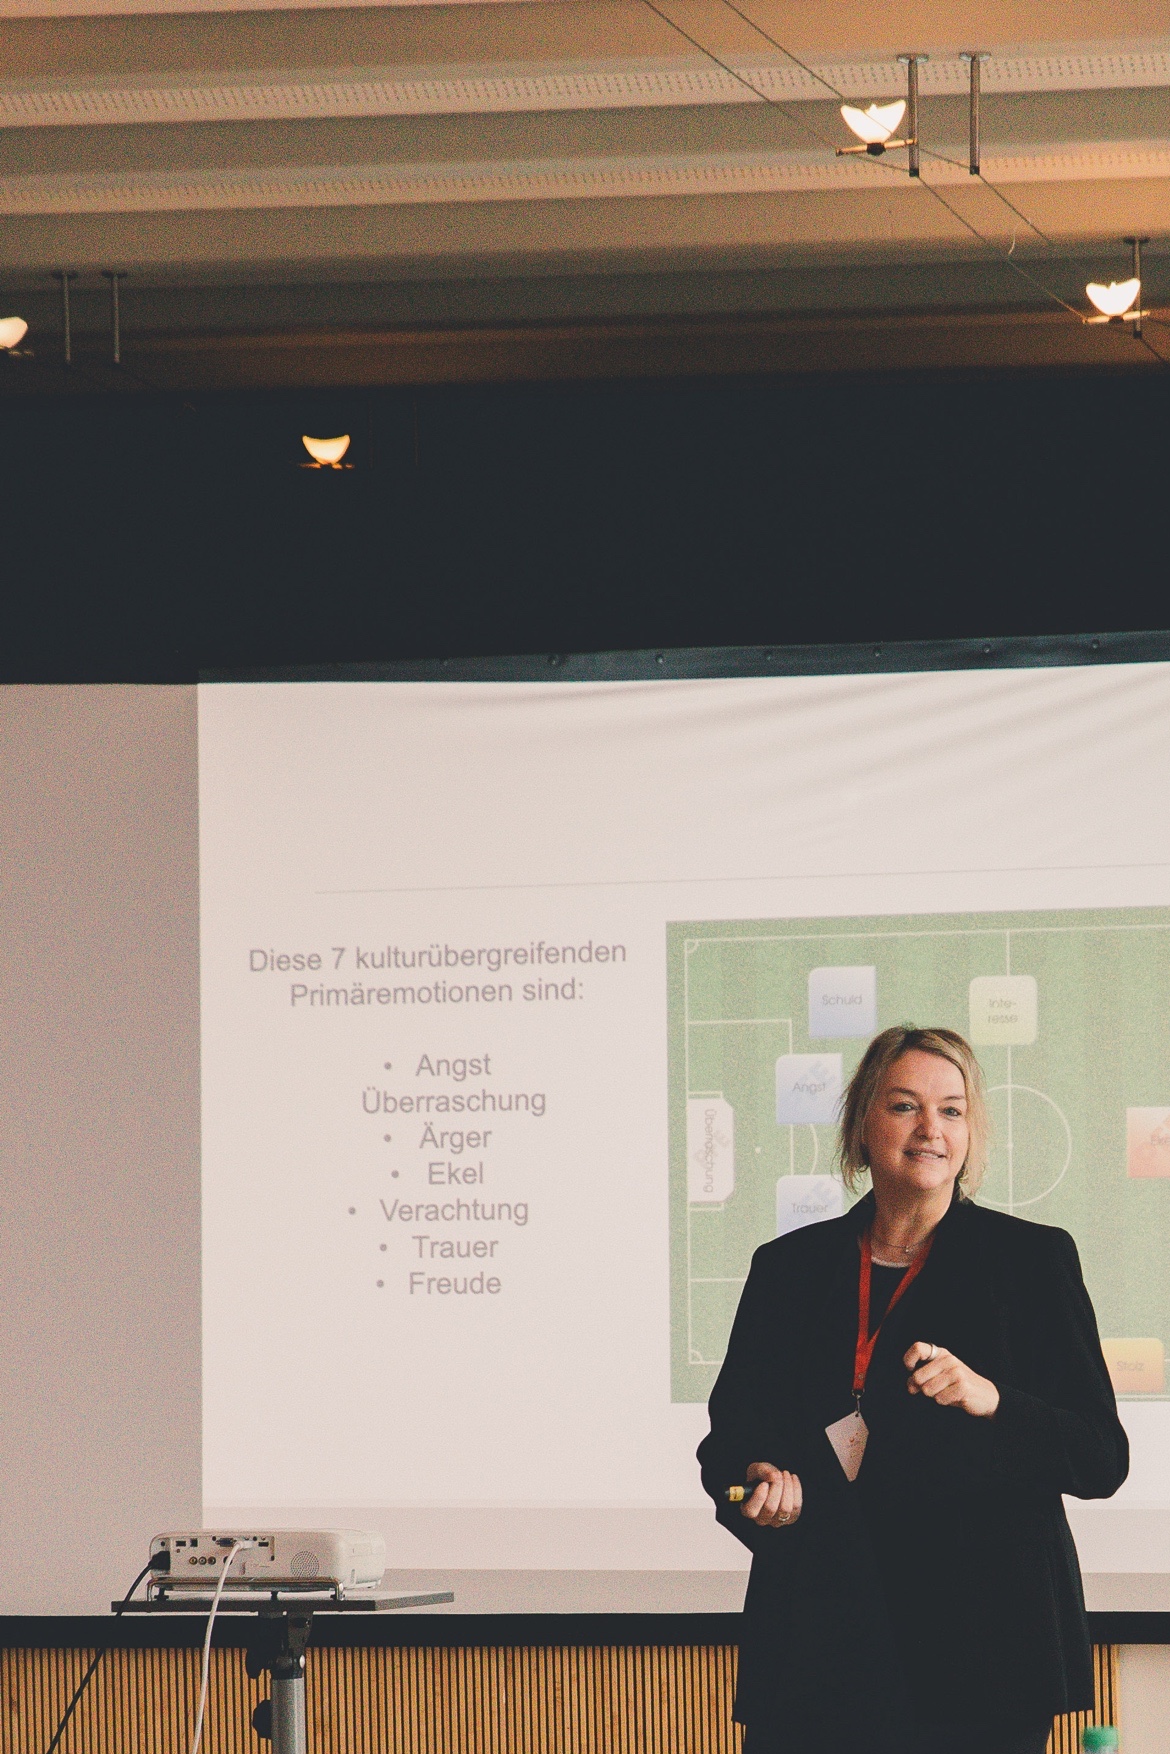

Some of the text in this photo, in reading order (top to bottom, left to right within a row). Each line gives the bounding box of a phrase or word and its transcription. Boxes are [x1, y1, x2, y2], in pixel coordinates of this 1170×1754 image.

[249, 940, 627, 972] Diese 7 kulturübergreifenden
[290, 977, 584, 1006] Primäremotionen sind:
[821, 993, 863, 1006] Schuld
[415, 1054, 492, 1082] Angst
[362, 1086, 547, 1117] Überraschung
[792, 1081, 827, 1095] Angst
[419, 1122, 493, 1154] Ärger
[428, 1162, 484, 1185] Ekel
[379, 1199, 529, 1226] Verachtung
[411, 1236, 499, 1259] Trauer
[409, 1272, 502, 1295] Freude
